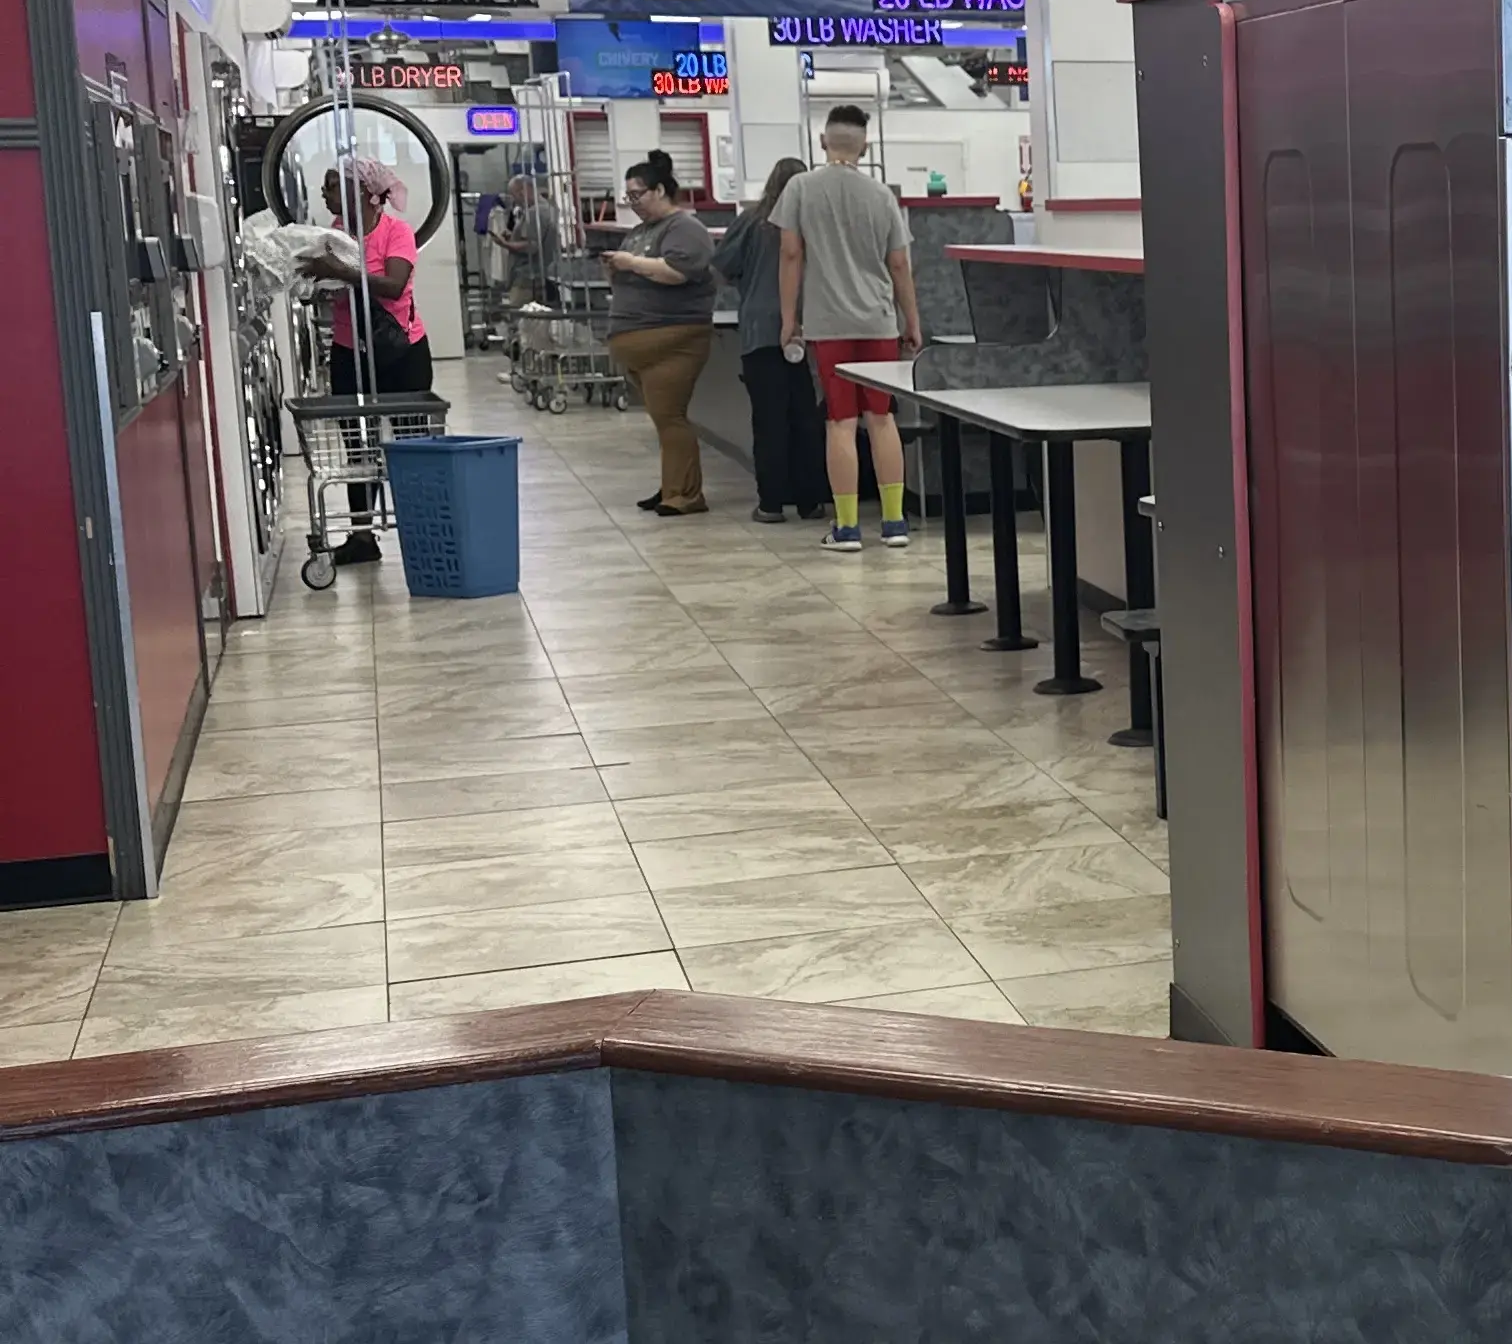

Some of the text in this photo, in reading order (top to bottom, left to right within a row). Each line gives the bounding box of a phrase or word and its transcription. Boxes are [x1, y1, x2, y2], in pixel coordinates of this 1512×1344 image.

[773, 16, 942, 44] 30 LB WASHER
[360, 66, 386, 88] LB
[391, 65, 463, 88] DRYER
[675, 52, 728, 78] 20 LB
[653, 71, 675, 96] 30
